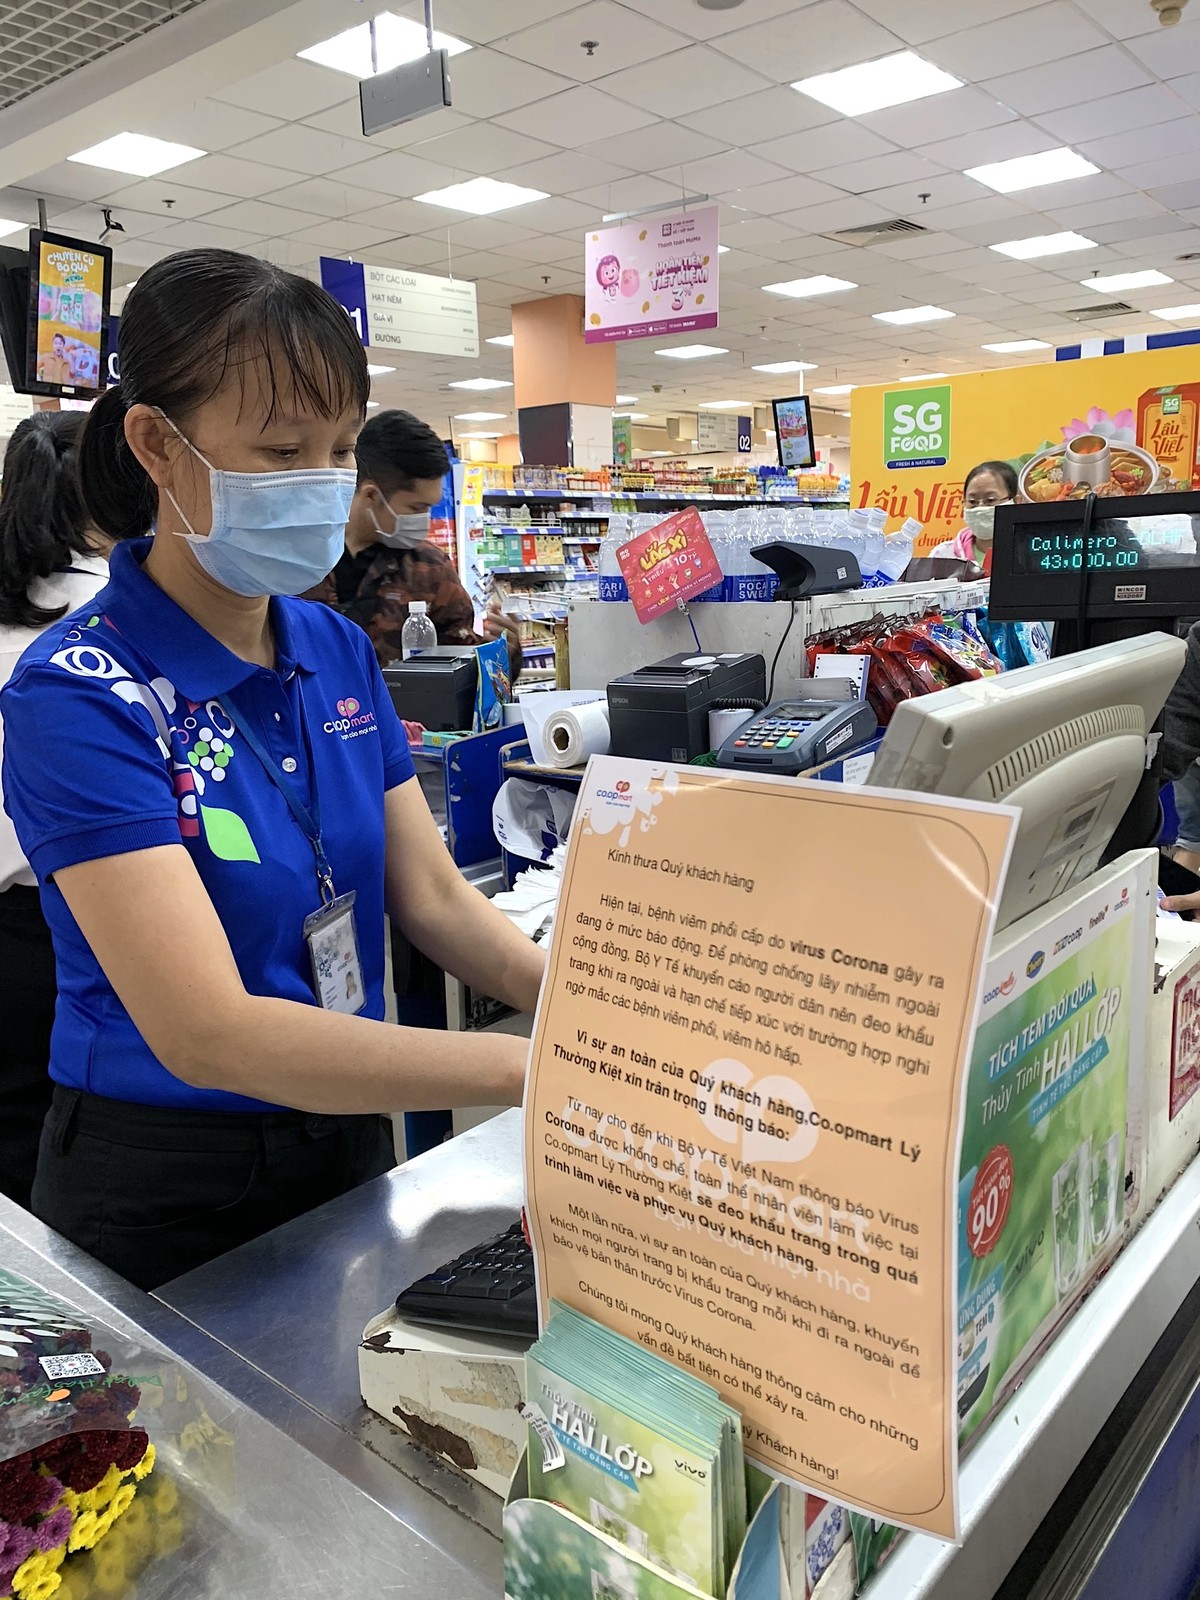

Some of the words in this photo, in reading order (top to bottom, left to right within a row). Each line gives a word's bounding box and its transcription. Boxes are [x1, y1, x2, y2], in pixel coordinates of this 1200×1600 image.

[370, 272, 384, 284] BỘT
[386, 275, 400, 284] CÁC
[892, 401, 942, 435] SG
[1165, 398, 1178, 407] SG
[739, 436, 750, 450] 02
[890, 433, 943, 453] FOOD
[913, 482, 965, 525] Việ
[673, 554, 688, 567] 10
[607, 848, 631, 865] Kính
[633, 854, 658, 871] thưa
[660, 858, 684, 879] Quý
[686, 864, 721, 883] khách
[723, 871, 755, 893] hàng
[599, 893, 624, 912] Hiện
[628, 901, 643, 916] tại,
[647, 905, 675, 923] bệnh
[679, 914, 707, 931] viêm
[710, 920, 737, 938] phổi
[741, 927, 764, 947] cấp
[768, 934, 786, 950] do
[790, 940, 826, 960] virus
[831, 949, 889, 976] Corona
[928, 973, 945, 990] ra
[982, 1084, 1013, 1126] Thủy
[1016, 1056, 1041, 1095] Tinh
[1040, 1021, 1080, 1094] HAI
[1082, 985, 1121, 1052] LỚP
[989, 1035, 1019, 1078] TÍCH
[1022, 1013, 1046, 1051] TEM
[553, 1043, 596, 1074] Thường
[599, 1060, 622, 1082] Kiệt
[624, 1072, 643, 1088] xin
[645, 1079, 670, 1098] trân
[673, 1089, 707, 1115] trọng
[714, 1103, 754, 1132] thông
[757, 1118, 790, 1142] báo:
[576, 1029, 588, 1044] Vì
[591, 1037, 608, 1053] sự
[611, 1044, 625, 1058] an
[630, 1050, 657, 1069] toàn
[661, 1061, 685, 1079] của
[689, 1069, 716, 1093] Quý
[719, 1079, 762, 1107] khách
[900, 1140, 922, 1163] Lý
[544, 1132, 599, 1166] Co.opmart
[602, 1155, 615, 1174] Lý
[617, 1162, 665, 1193] Thường
[668, 1182, 693, 1201] Kiệt
[696, 1194, 713, 1209] sẽ
[717, 1201, 745, 1221] đeo
[750, 1212, 786, 1236] khẩu
[791, 1228, 832, 1256] trang
[837, 1245, 881, 1274] trong
[886, 1264, 919, 1285] quá
[1015, 1230, 1045, 1274] vivo
[976, 1313, 987, 1336] TEM
[578, 1280, 613, 1308] Chúng
[615, 1298, 629, 1314] tôi
[630, 1307, 663, 1333] mong
[664, 1322, 689, 1345] Quý
[691, 1334, 728, 1362] khách
[730, 1353, 763, 1380] hàng
[765, 1369, 802, 1399] thông
[806, 1391, 836, 1412] cảm
[839, 1405, 867, 1425] cho
[869, 1418, 919, 1451] những
[637, 1331, 658, 1349] vấn
[660, 1342, 675, 1357] đề
[677, 1349, 696, 1368] bất
[698, 1360, 721, 1380] tiện
[723, 1374, 740, 1388] có
[742, 1381, 763, 1399] thể
[765, 1392, 788, 1414] xảy
[791, 1406, 809, 1423] ra.
[551, 1403, 596, 1449] HAI
[600, 1433, 654, 1479] LỚP
[756, 1429, 797, 1461] Khách
[800, 1454, 839, 1480] hàng!
[674, 1458, 706, 1479] vivo
